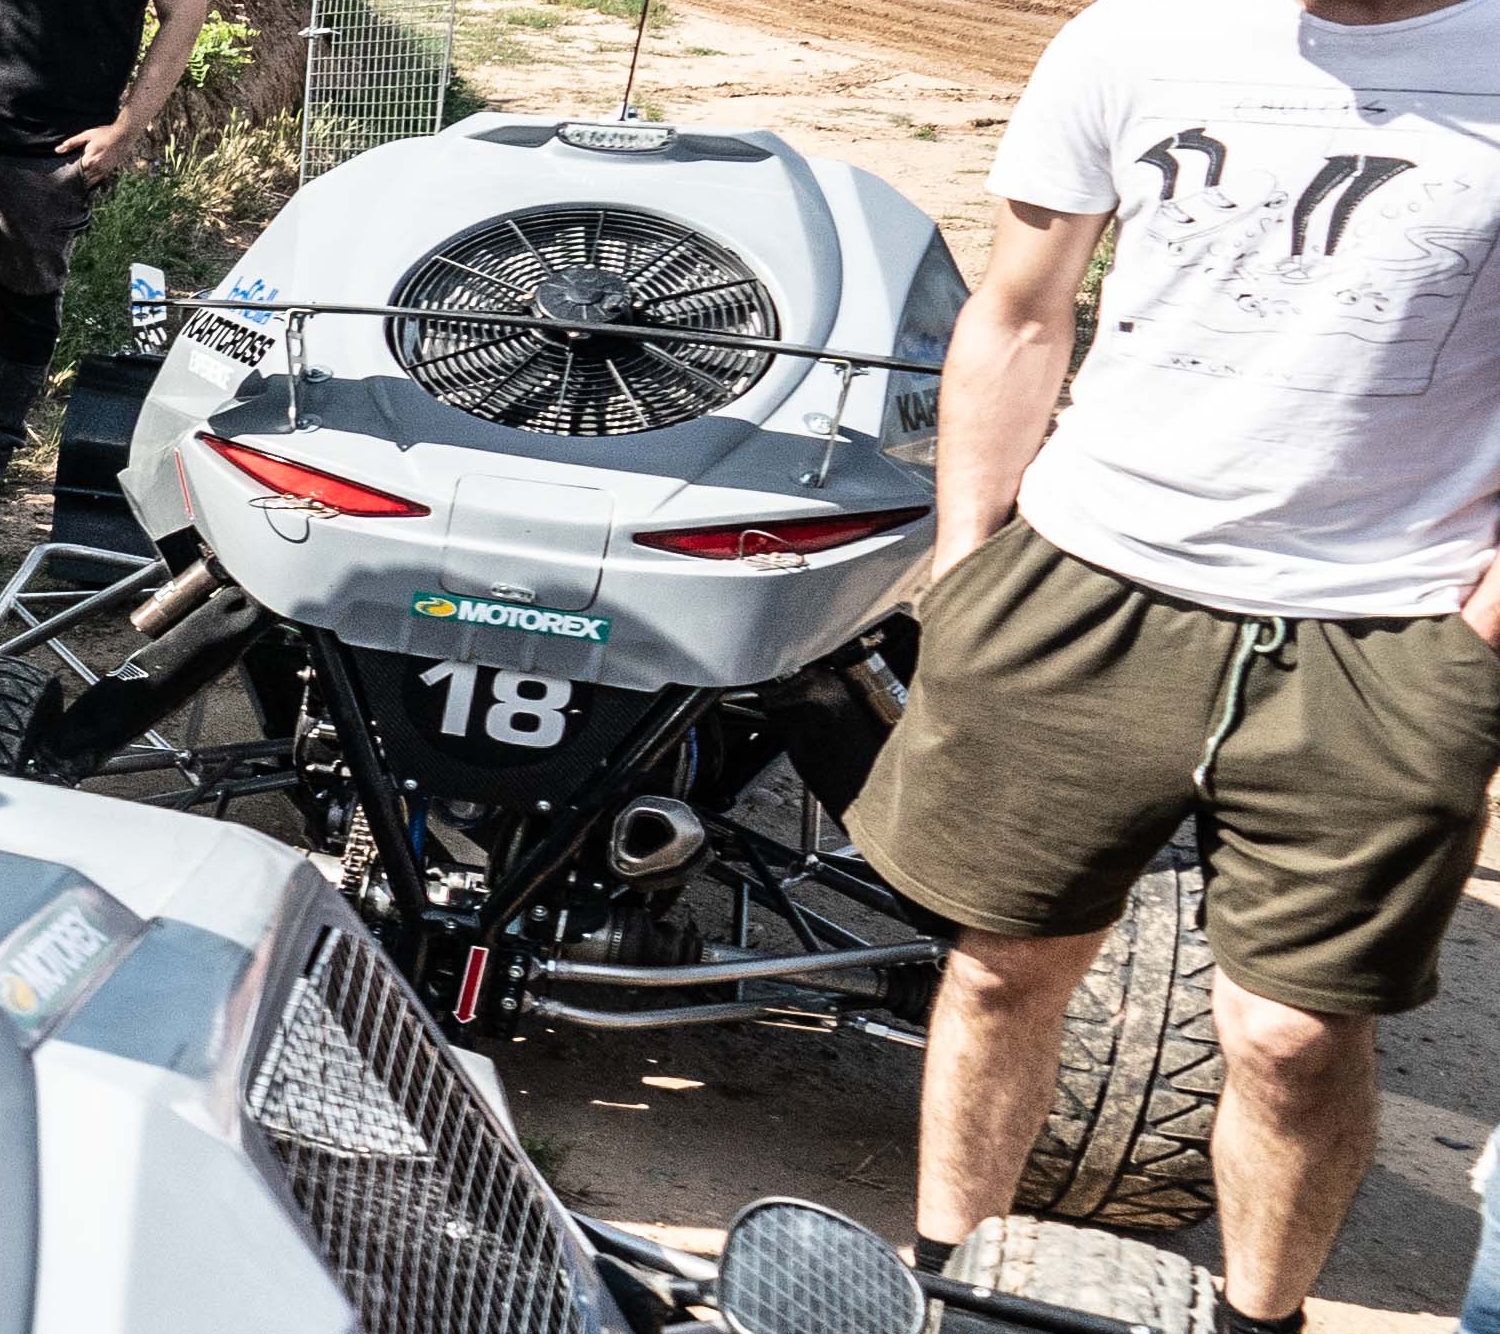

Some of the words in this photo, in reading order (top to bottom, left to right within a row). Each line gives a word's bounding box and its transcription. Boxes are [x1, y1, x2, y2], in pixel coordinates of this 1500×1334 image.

[181, 308, 276, 368] KARTCROSS
[456, 599, 606, 641] MOTOREX
[418, 660, 573, 750] 18
[10, 905, 109, 1001] MOTOREX
